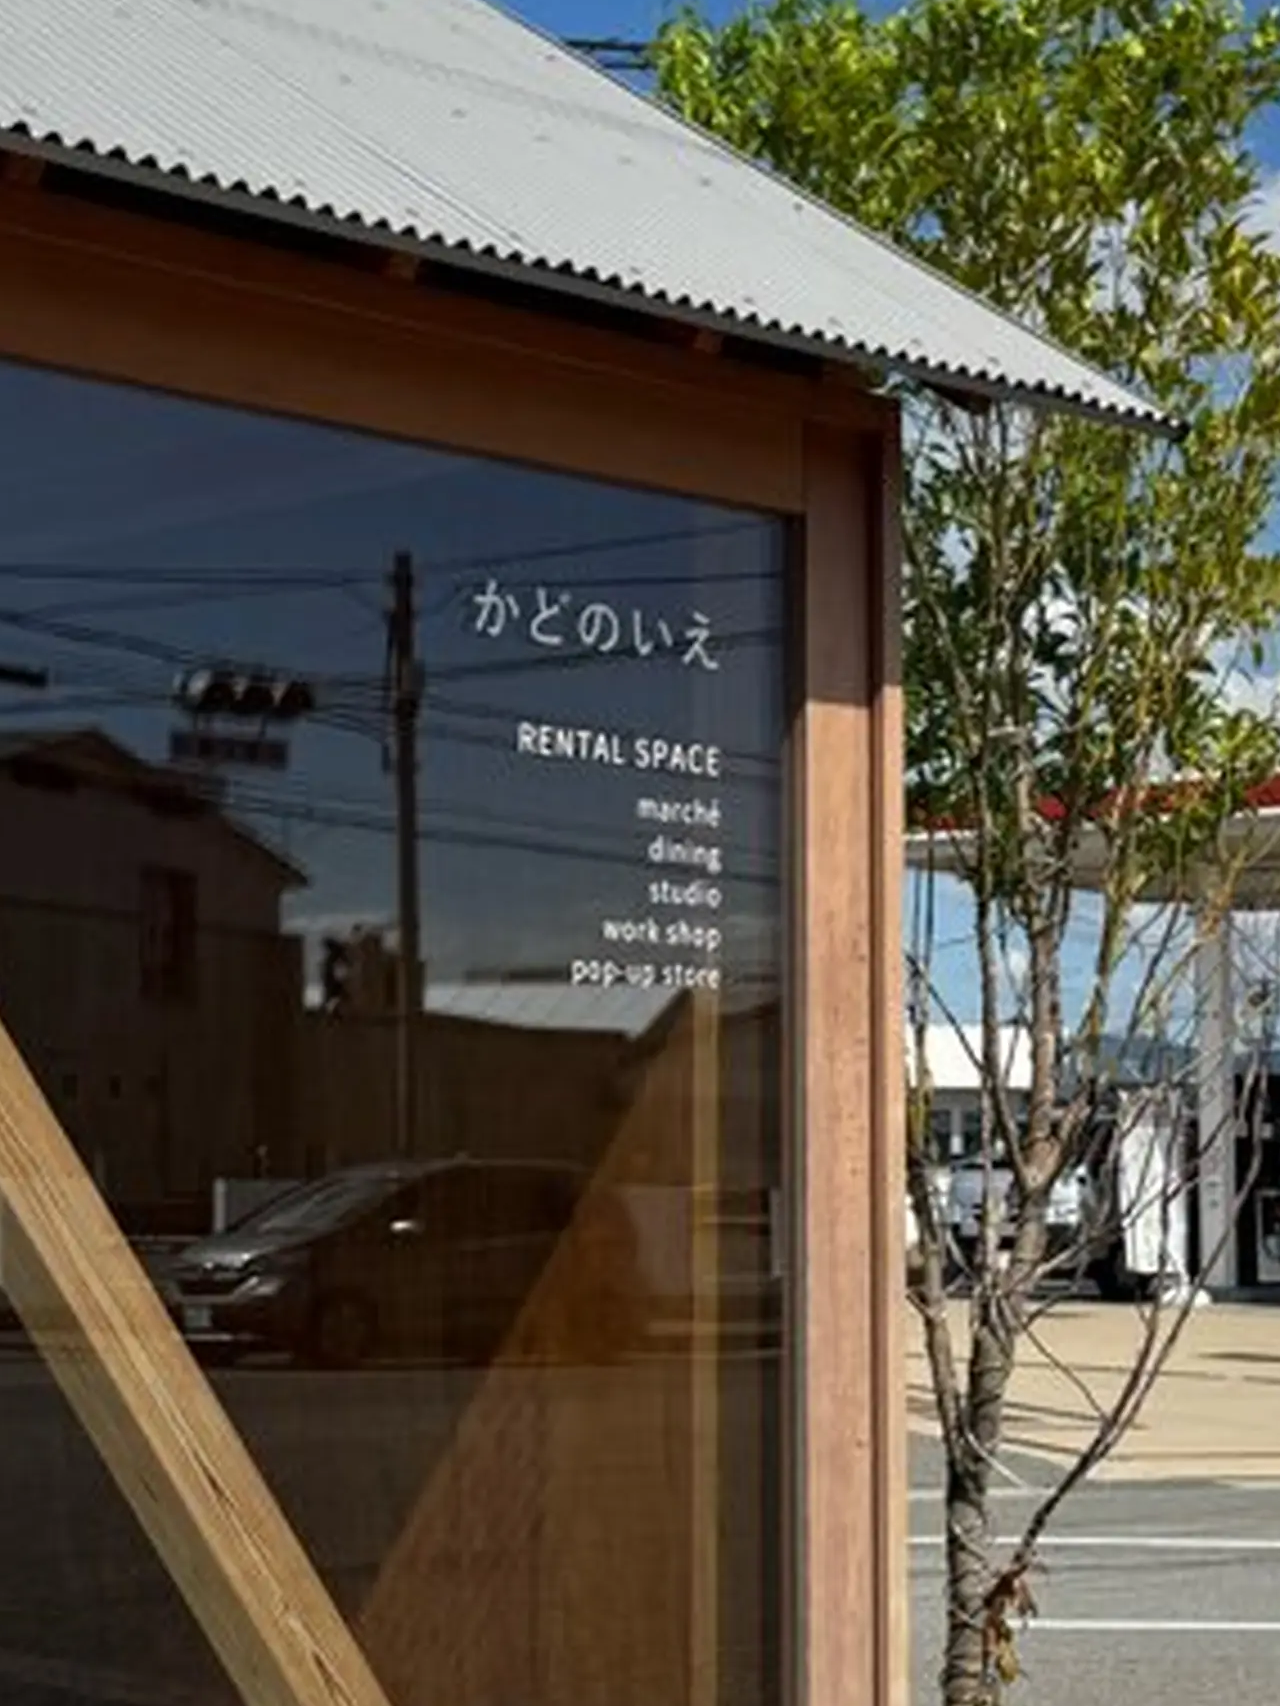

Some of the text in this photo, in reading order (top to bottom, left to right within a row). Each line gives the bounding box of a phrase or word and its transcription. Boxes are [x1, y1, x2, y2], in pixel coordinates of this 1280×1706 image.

[472, 579, 720, 670] かどのいえ
[517, 720, 721, 778] RENTAL SPACE
[637, 795, 721, 827] marché
[647, 835, 722, 875] dining
[649, 879, 722, 909] studio
[602, 915, 722, 952] work shop
[570, 957, 721, 989] pop-up store
